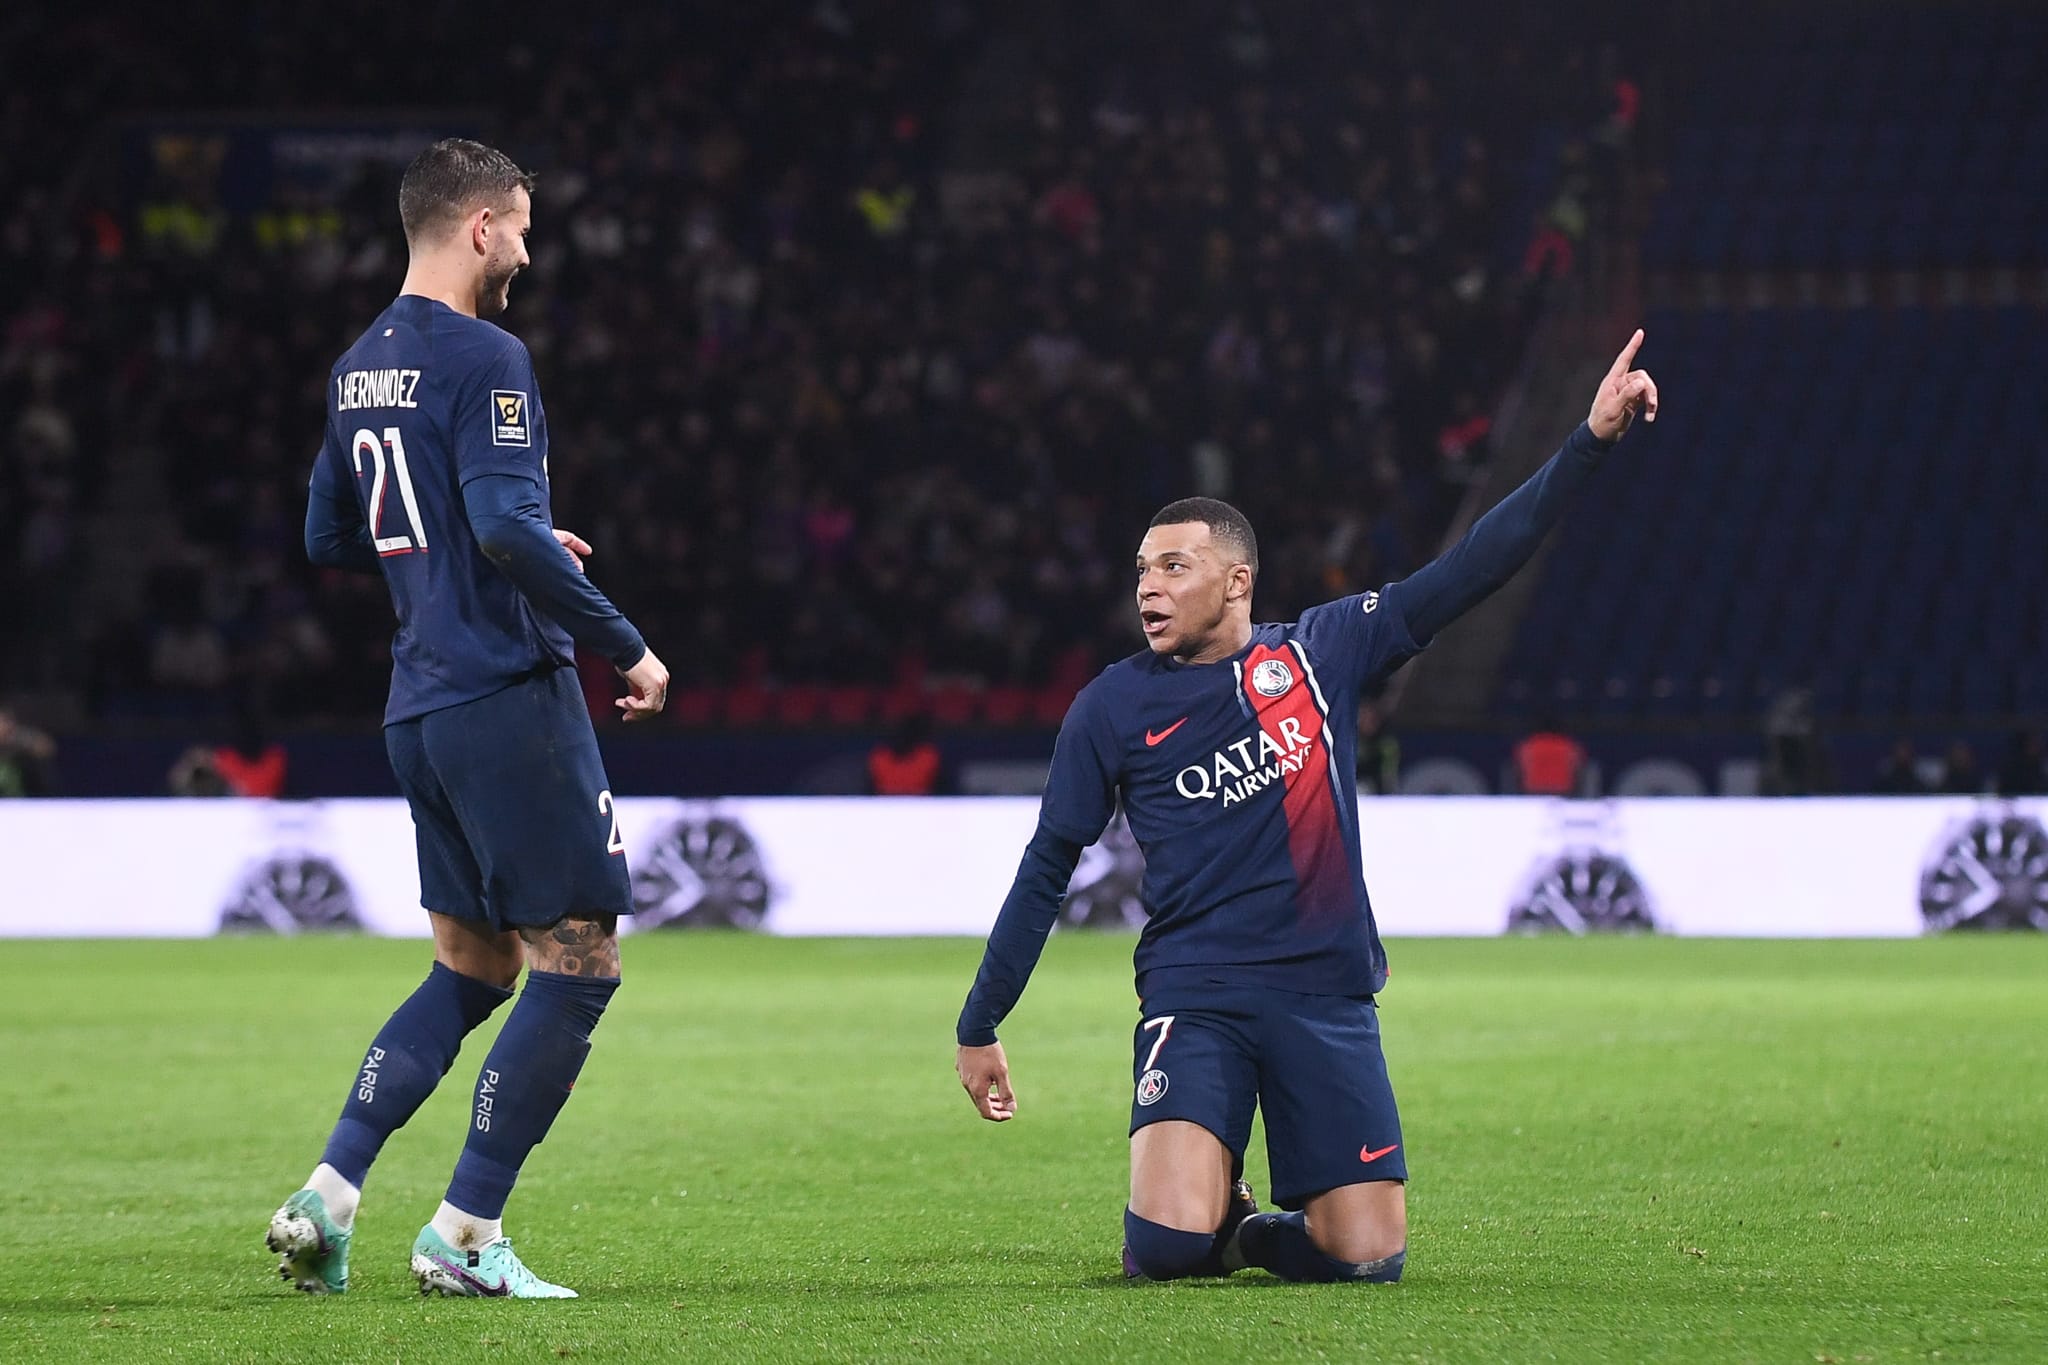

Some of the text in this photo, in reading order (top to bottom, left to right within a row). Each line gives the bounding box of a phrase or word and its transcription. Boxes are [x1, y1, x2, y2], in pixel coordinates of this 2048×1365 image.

[353, 427, 428, 557] 21
[1175, 716, 1312, 800] QATAR
[358, 1046, 386, 1103] PARIS
[1143, 1015, 1176, 1072] 7
[476, 1069, 500, 1133] PARIS
